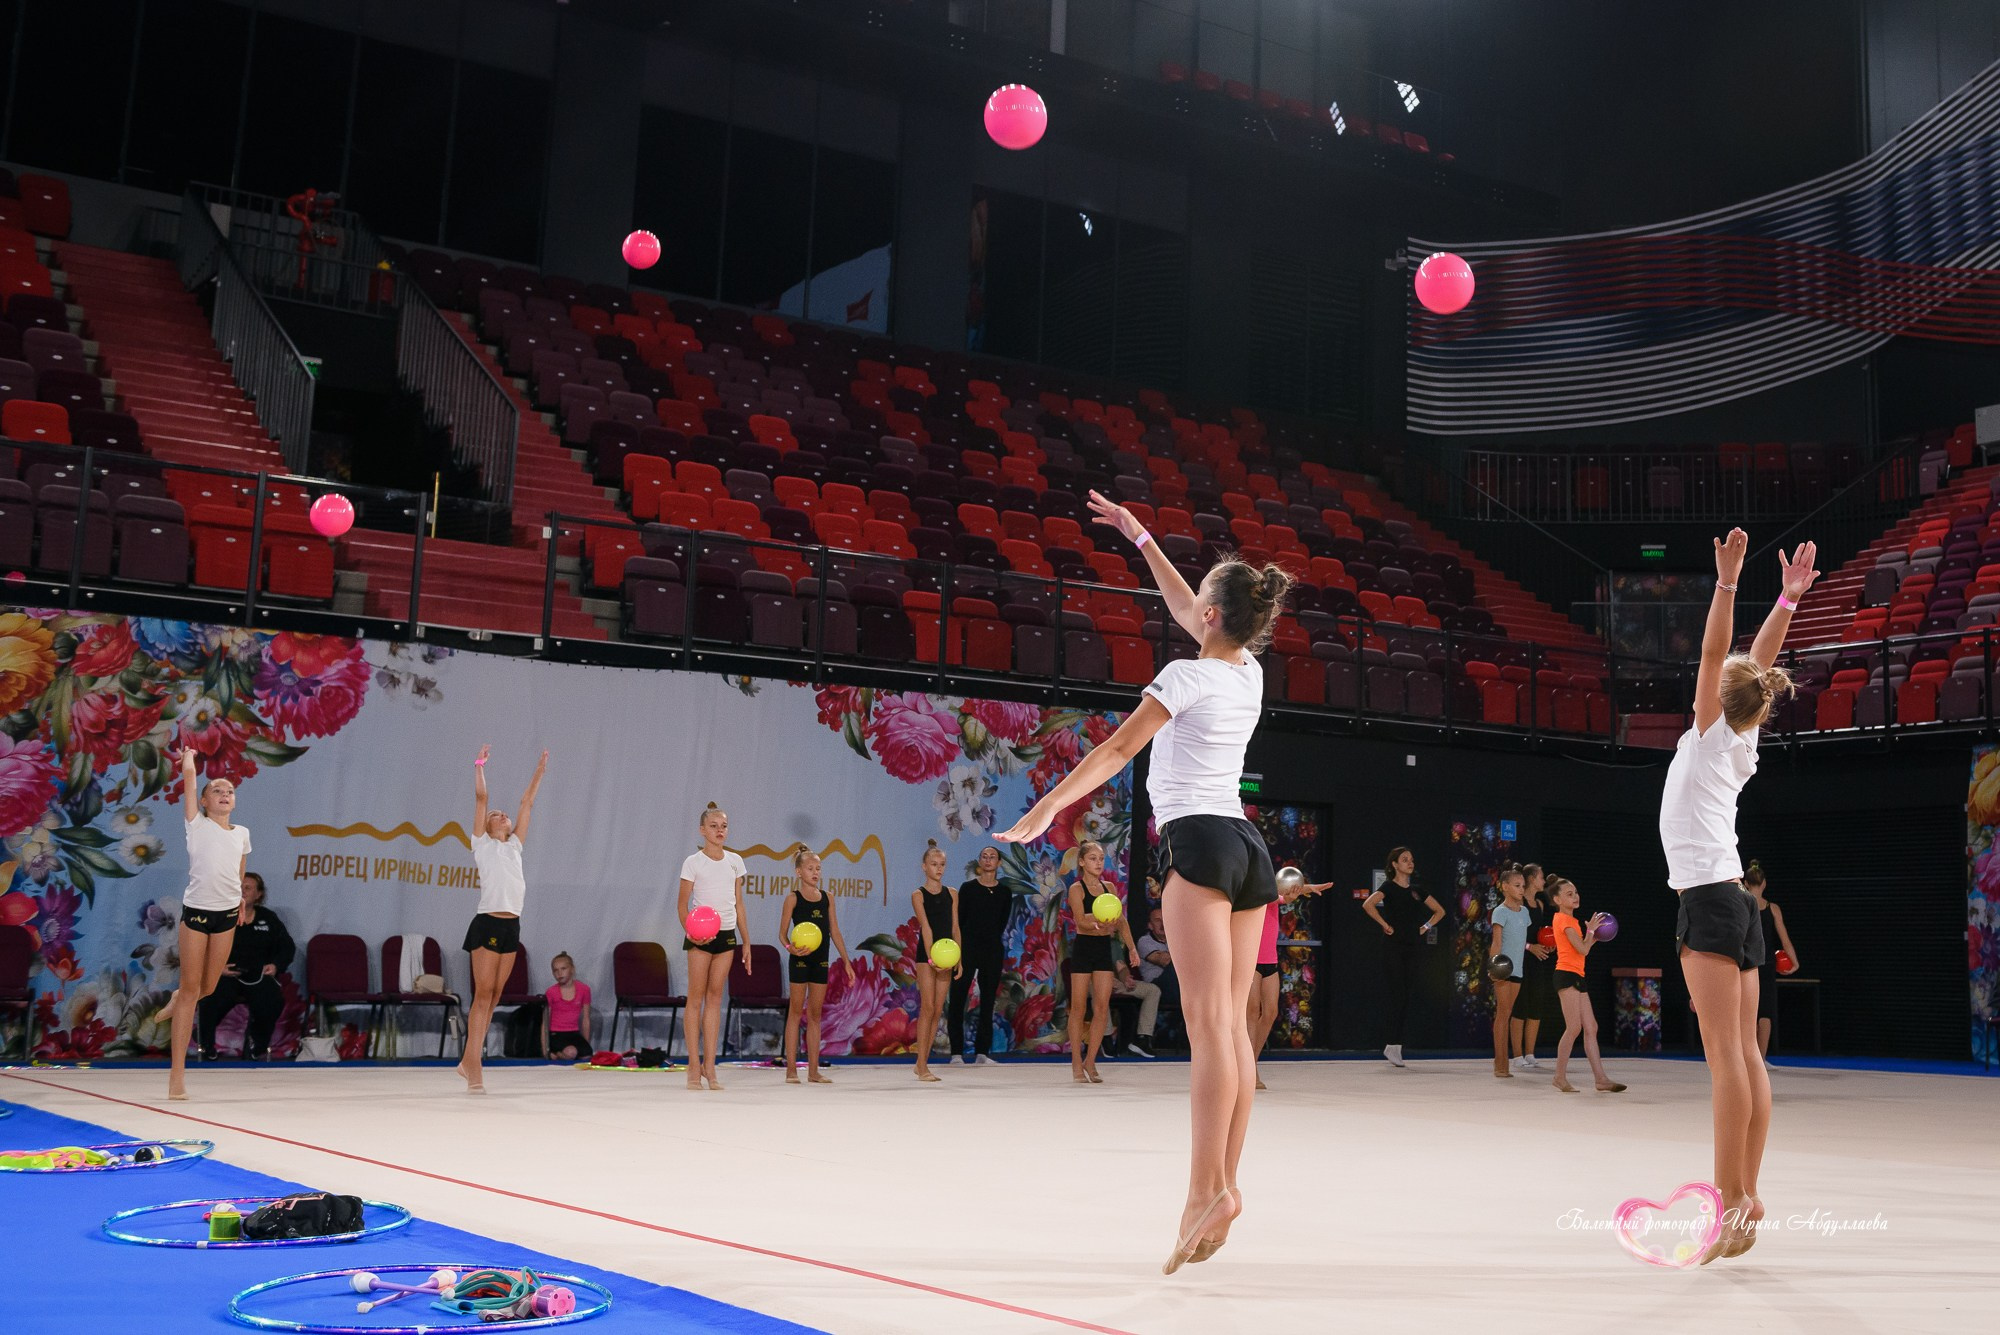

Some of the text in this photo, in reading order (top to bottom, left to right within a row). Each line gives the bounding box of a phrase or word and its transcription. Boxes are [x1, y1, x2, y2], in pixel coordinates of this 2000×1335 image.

[294, 854, 481, 889] ДВОРЕЦ ИРИНЫ ВИНЕ
[769, 876, 823, 896] ИРИ
[828, 878, 873, 898] ВИНЕР
